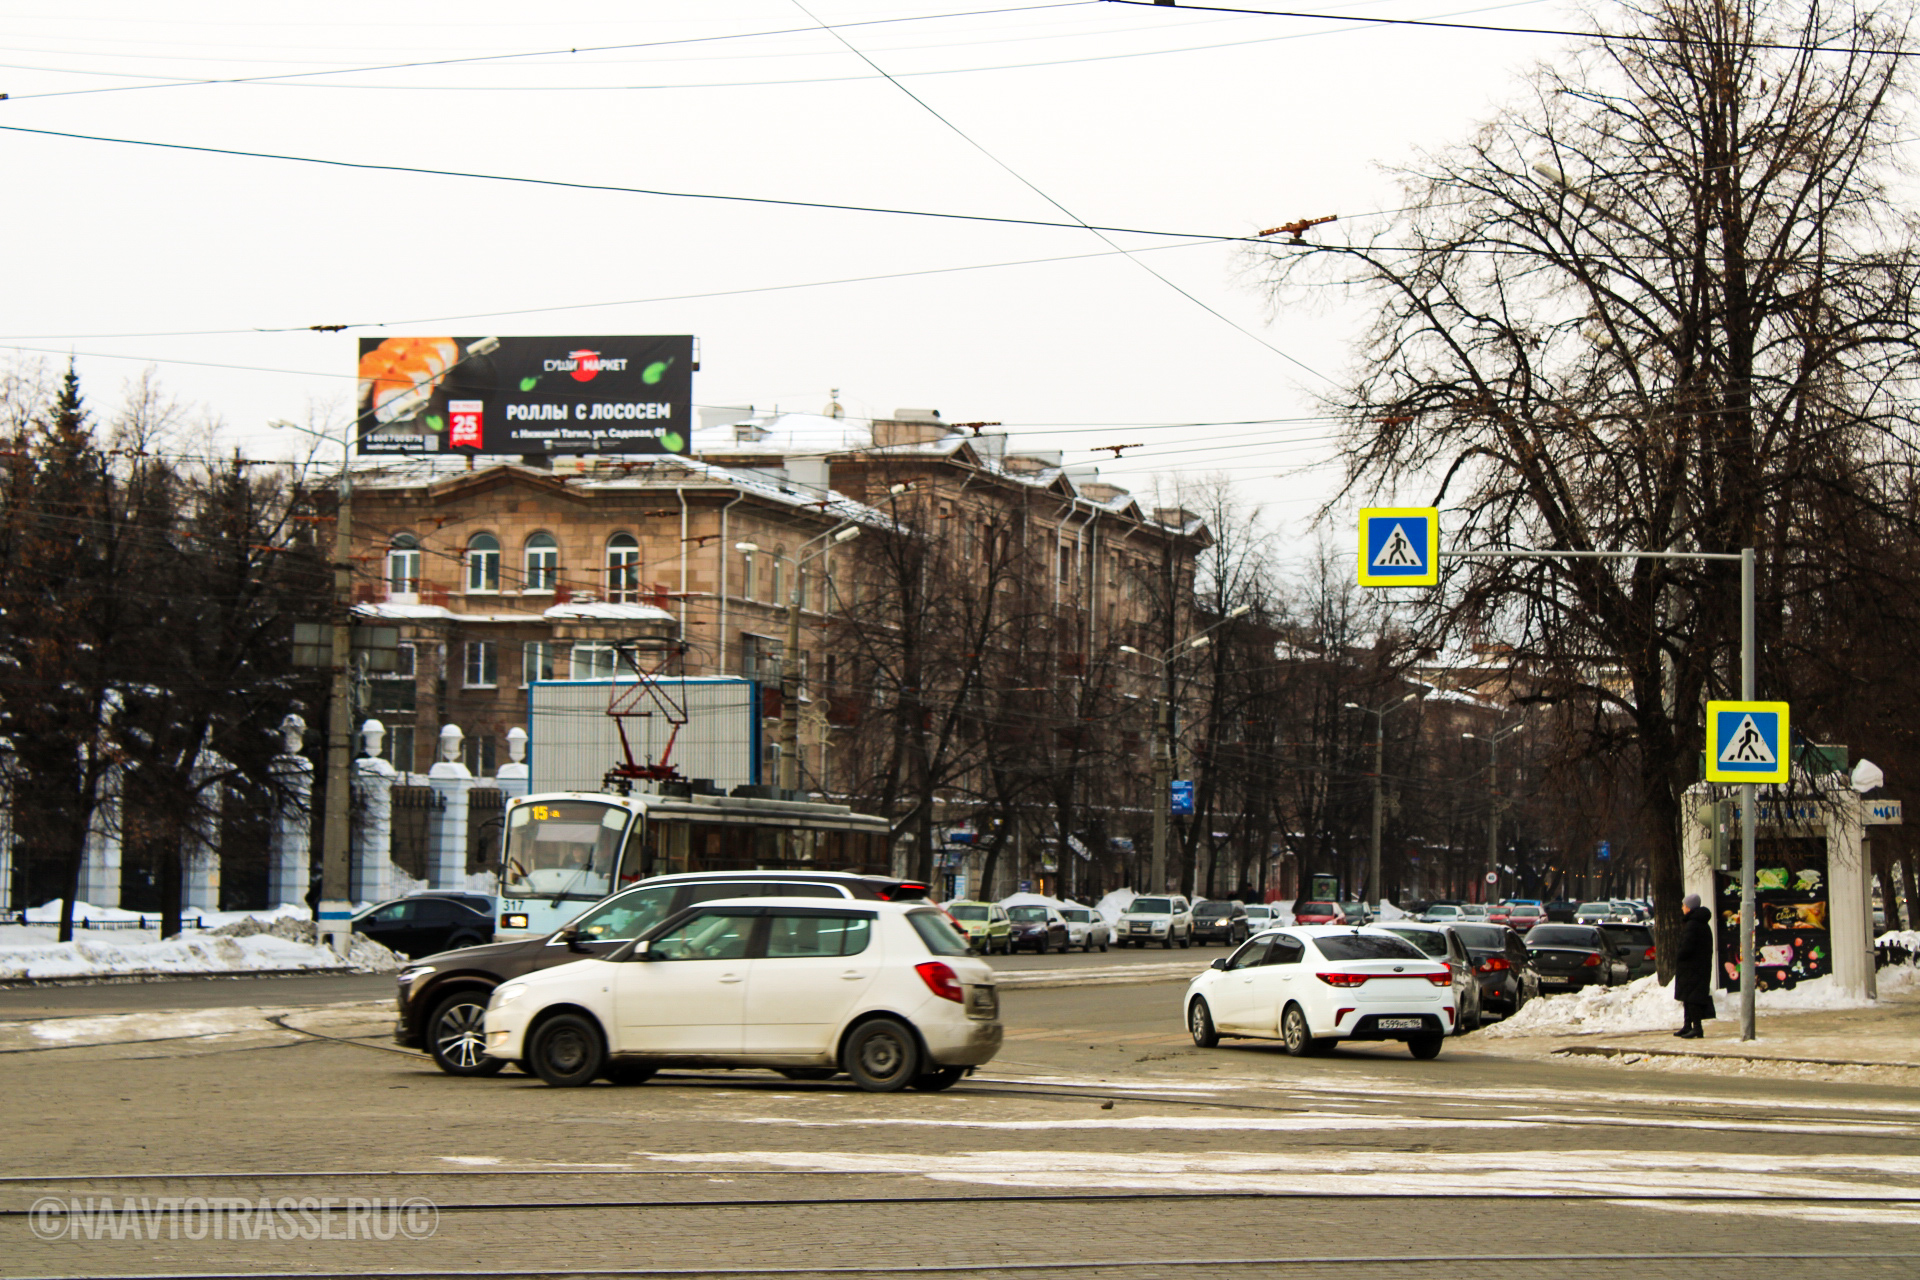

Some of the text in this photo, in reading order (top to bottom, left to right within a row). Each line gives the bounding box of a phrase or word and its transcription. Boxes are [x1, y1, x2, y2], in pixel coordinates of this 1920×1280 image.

[583, 359, 628, 371] МАРКЕТ
[506, 402, 671, 420] РОЛЛЫ С ЛОСОСЕМ
[453, 415, 477, 433] 25
[520, 428, 560, 438] Нижний
[503, 900, 525, 911] 317
